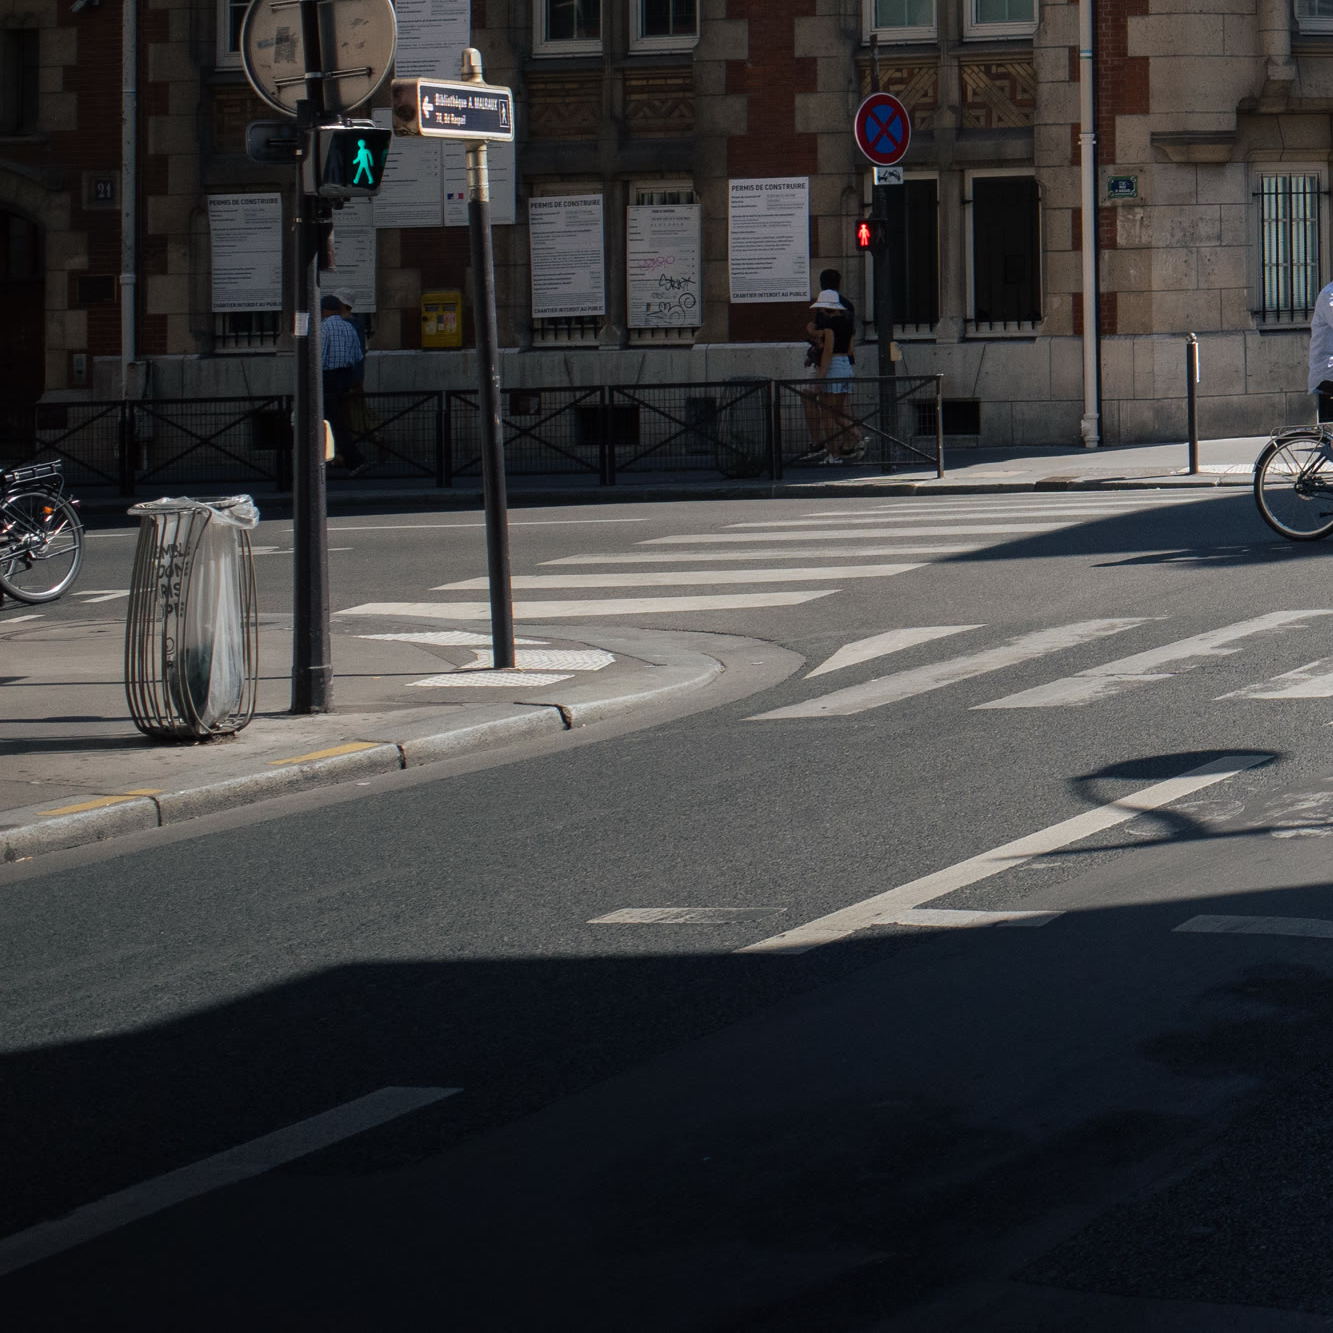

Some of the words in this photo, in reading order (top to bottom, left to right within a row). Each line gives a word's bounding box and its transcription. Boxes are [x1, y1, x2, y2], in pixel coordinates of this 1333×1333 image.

[97, 182, 111, 198] 21
[765, 183, 805, 191] CONSTRUIRE
[241, 197, 279, 205] CONSTRUIRE
[563, 199, 600, 207] CONSTRUIRE
